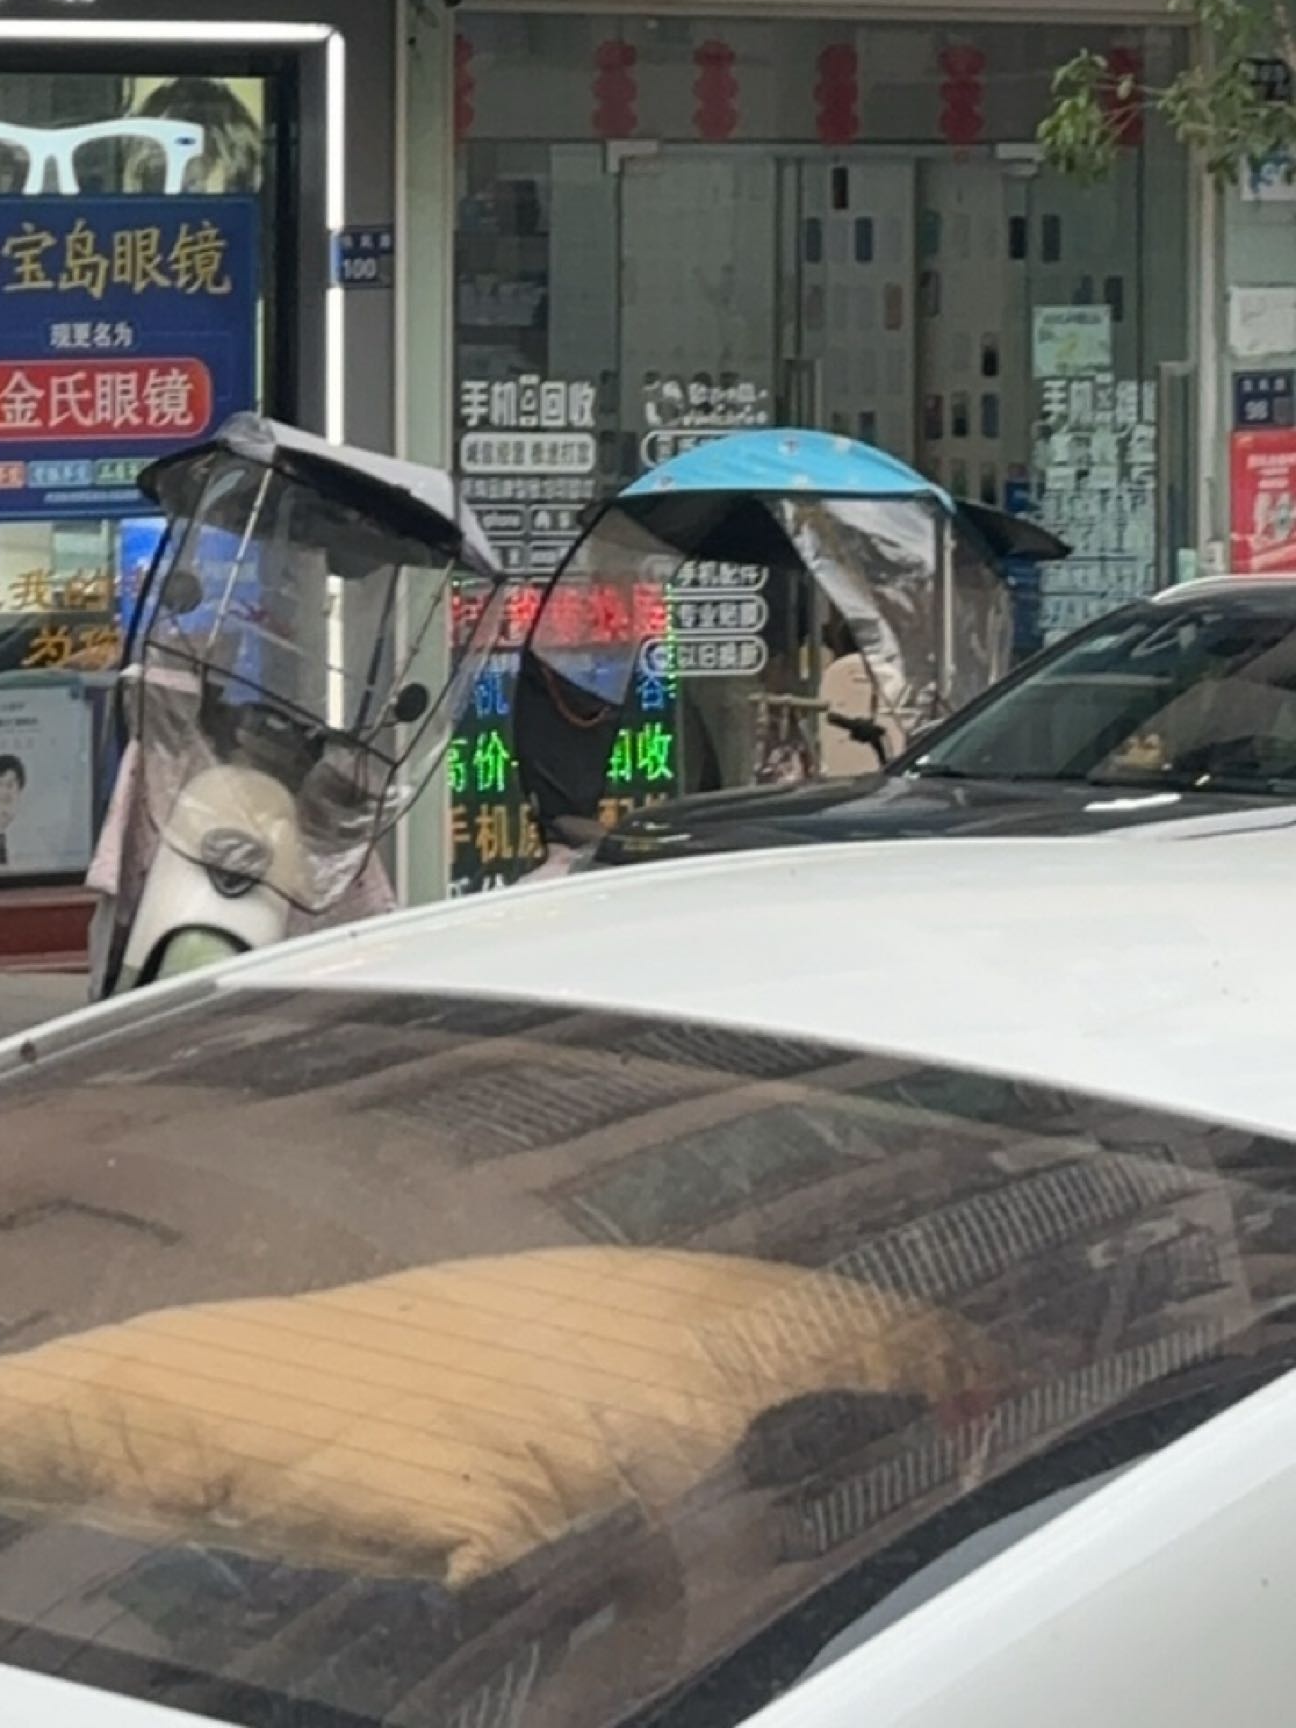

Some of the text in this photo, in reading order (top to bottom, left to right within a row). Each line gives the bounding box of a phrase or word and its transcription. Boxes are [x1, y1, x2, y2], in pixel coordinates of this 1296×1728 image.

[1, 218, 233, 300] 宝岛眼镜
[49, 322, 135, 349] 现更名为
